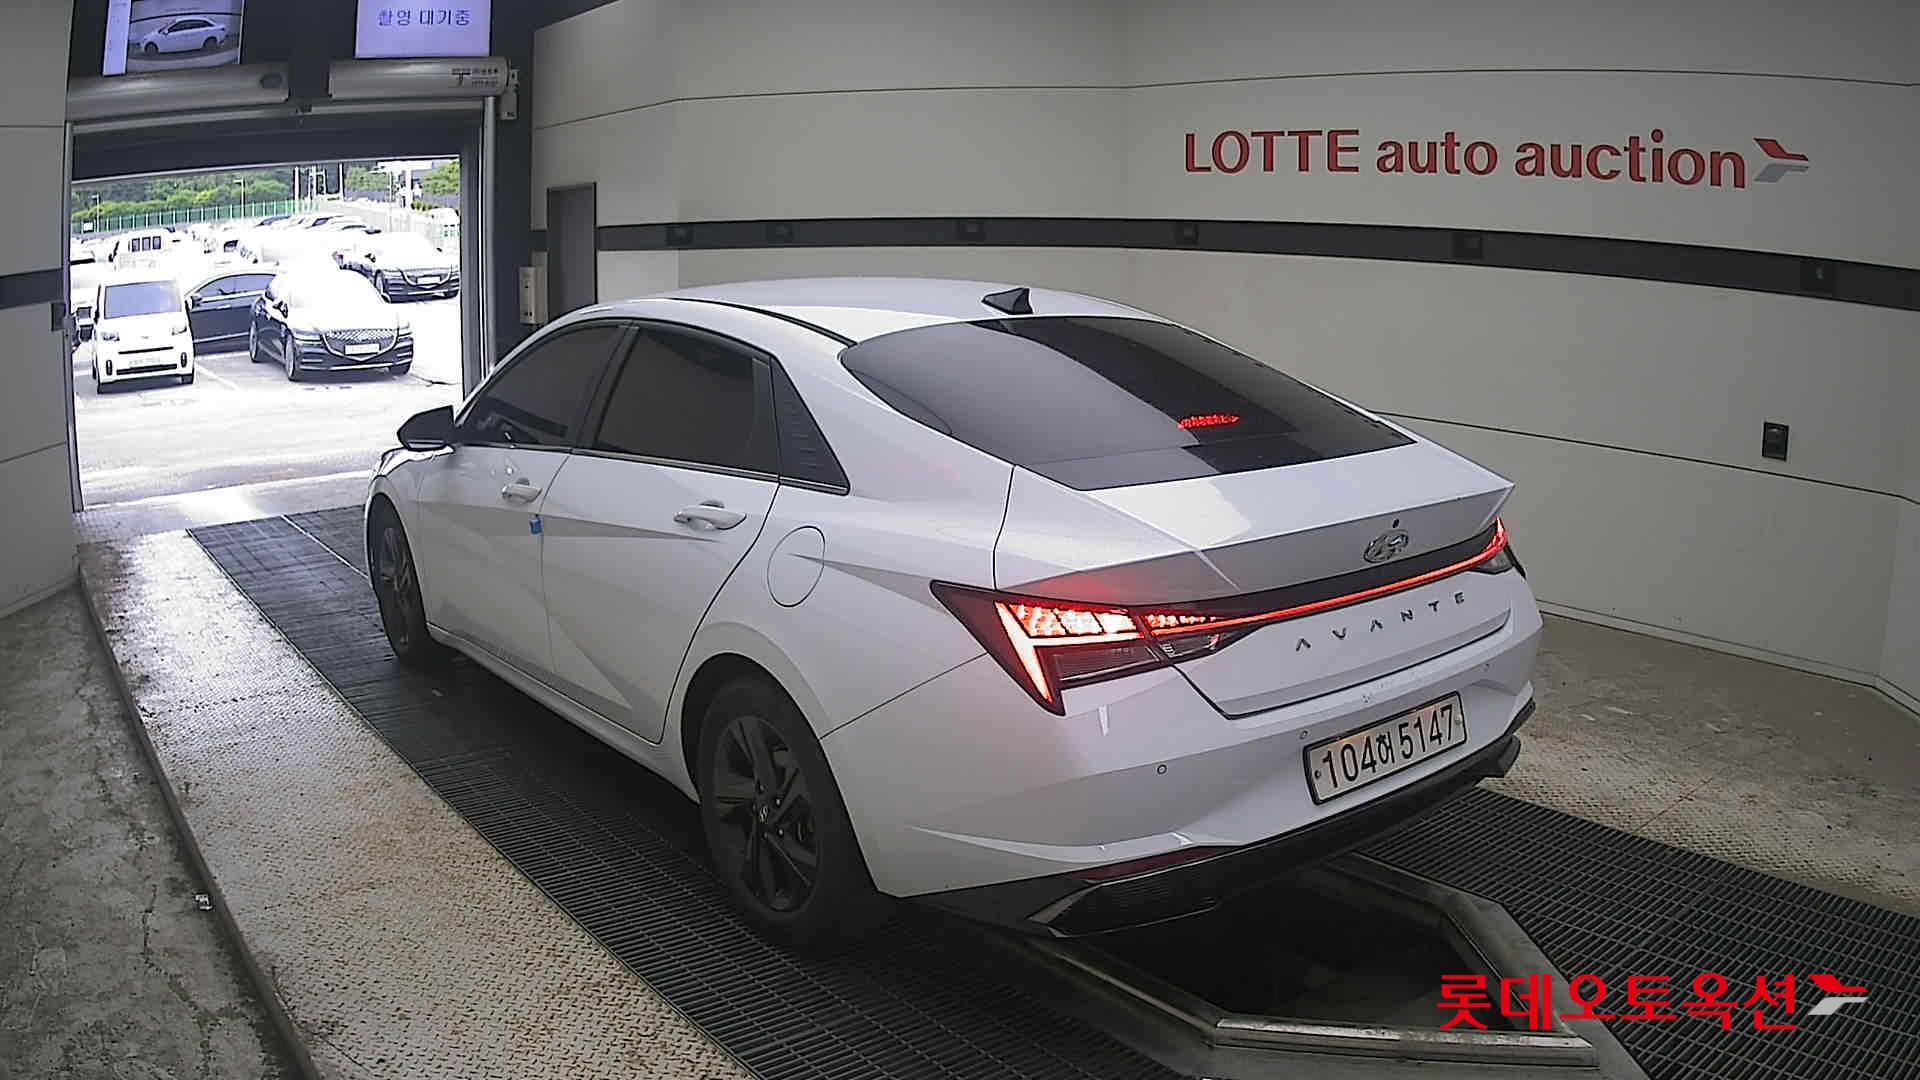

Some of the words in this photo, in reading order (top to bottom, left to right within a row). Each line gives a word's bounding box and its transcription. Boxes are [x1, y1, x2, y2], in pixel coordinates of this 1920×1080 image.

[419, 9, 471, 26] 대기중
[1185, 129, 1360, 174] LOTTE
[1376, 131, 1499, 176] auto
[1515, 128, 1745, 189] auction
[1296, 592, 1465, 651] AVANTE
